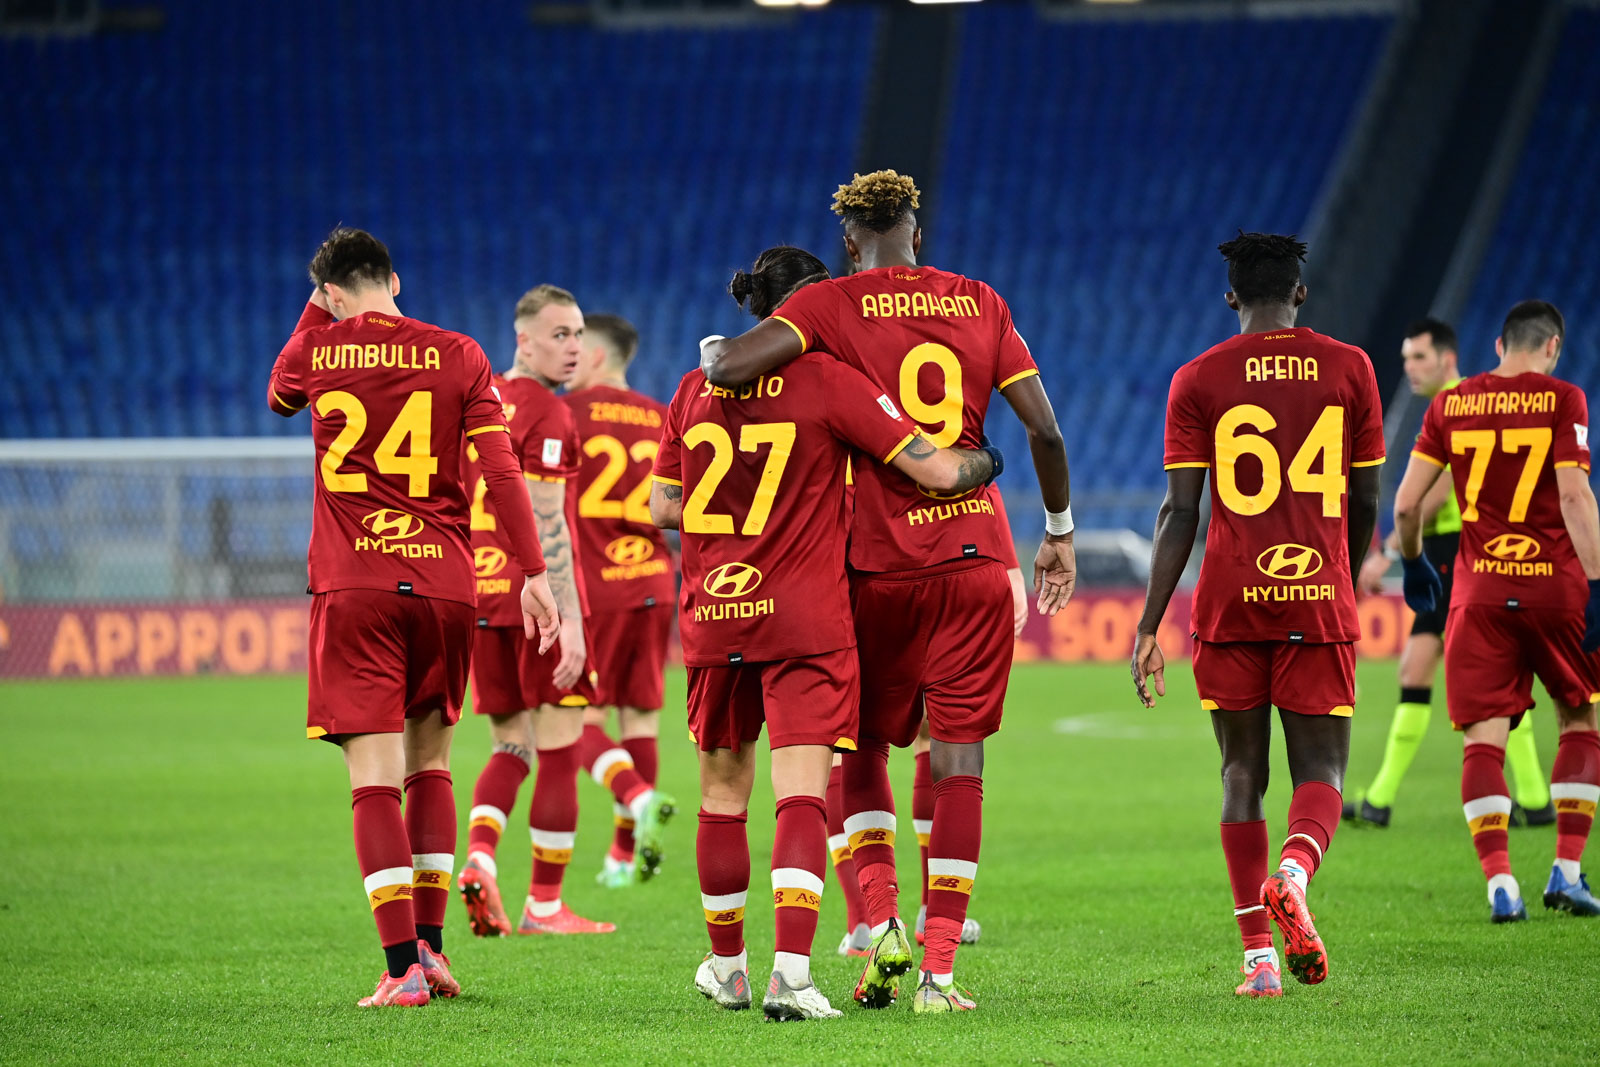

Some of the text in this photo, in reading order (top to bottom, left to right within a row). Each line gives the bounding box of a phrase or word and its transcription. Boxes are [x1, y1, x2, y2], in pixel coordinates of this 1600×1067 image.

[862, 292, 980, 317] ABRAHAM
[312, 344, 440, 370] KUMBULLA
[1246, 356, 1318, 381] AFENA
[898, 342, 964, 449] 9
[1444, 391, 1556, 416] MKHITARYAN
[316, 391, 438, 497] 24
[1215, 404, 1346, 517] 64
[579, 434, 660, 525] 22
[682, 422, 796, 535] 27
[1451, 427, 1552, 522] 77
[907, 499, 994, 526] HYUNDAI
[355, 537, 443, 558] HYUNDAI
[1473, 559, 1553, 576] HYUNDAI
[1243, 585, 1335, 602] HYUNDAI
[695, 598, 774, 621] HYUNDAI
